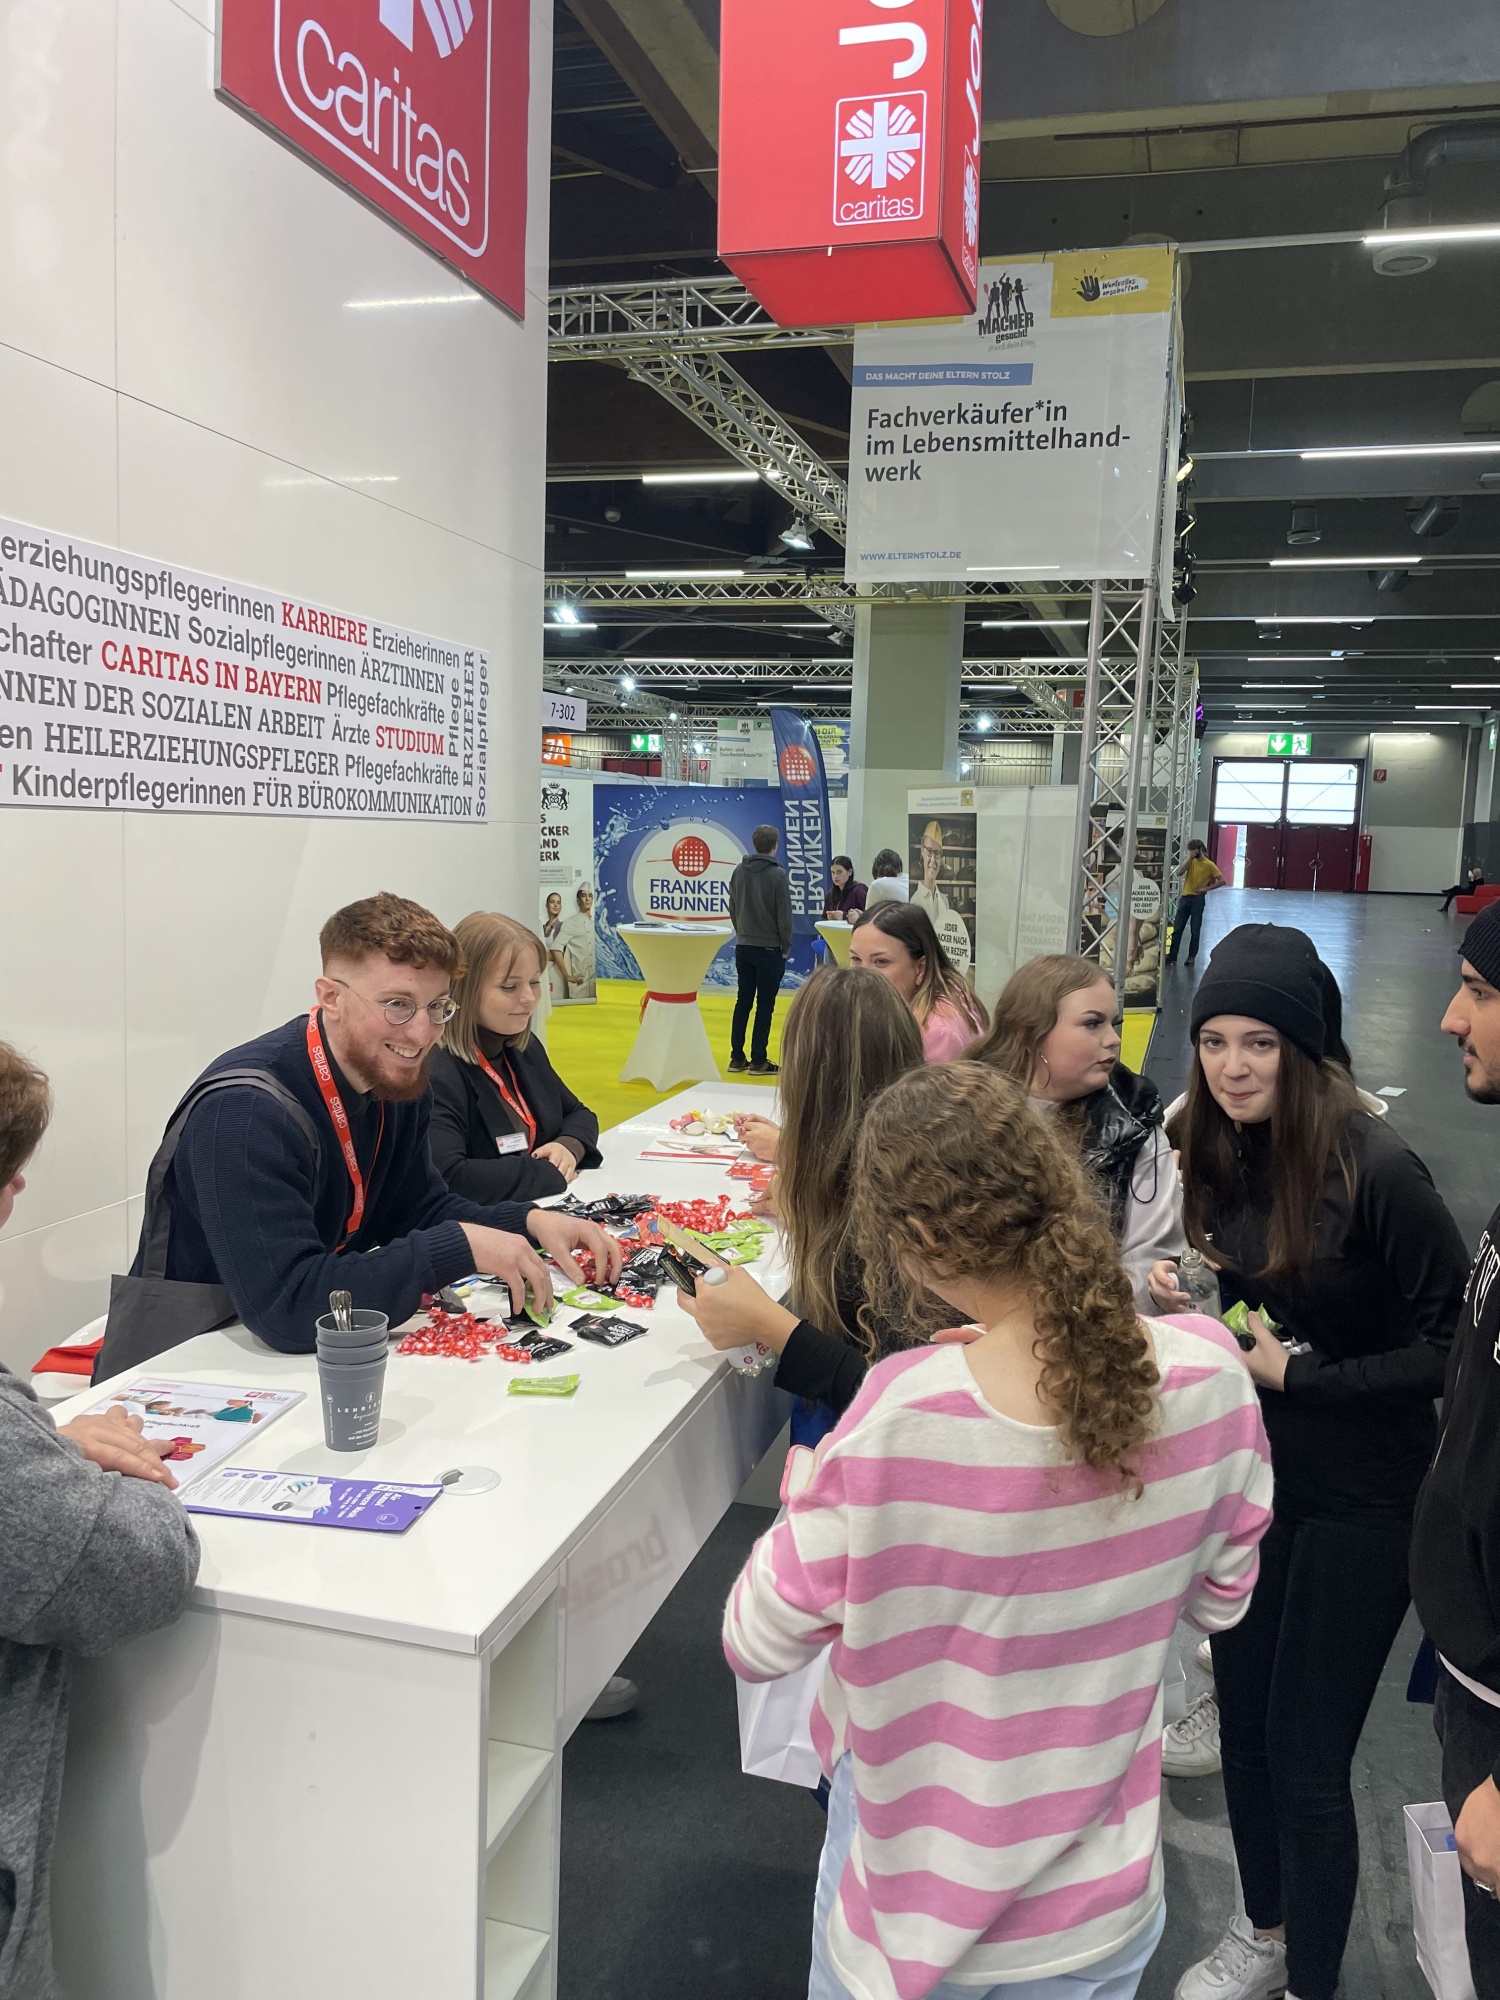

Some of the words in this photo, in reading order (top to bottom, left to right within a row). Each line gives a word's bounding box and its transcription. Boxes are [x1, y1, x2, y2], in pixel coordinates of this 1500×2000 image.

[297, 18, 471, 227] caritas
[840, 194, 914, 222] caritas
[978, 312, 1034, 336] MACHER
[865, 372, 884, 382] DAS
[885, 371, 917, 381] MACHT
[918, 371, 944, 381] DEINE
[945, 371, 979, 380] ELTERN
[981, 370, 1010, 380] STOLZ
[866, 434, 895, 456] im
[902, 425, 1131, 455] Lebensmittelhand-
[865, 459, 922, 482] werk
[860, 551, 962, 561] WWW.ELTERNSTOLZ.DE
[281, 601, 368, 646] KARRIERE
[373, 626, 460, 669] Erzieherinnen
[188, 616, 356, 676] Sozialpflegerinnen
[360, 651, 445, 695] ÄRZTINNEN
[101, 640, 209, 686] CARITAS
[215, 661, 239, 691] IN
[245, 667, 322, 705] BAYERN
[327, 682, 445, 725] Pflegefachkräfte
[84, 681, 135, 716] DER
[142, 690, 253, 731] SOZIALEN
[257, 708, 325, 740] ARBEIT
[332, 713, 370, 746] Ärzte
[375, 725, 445, 755] STUDIUM
[449, 677, 462, 758] Pflege
[463, 651, 474, 788] ERZIEHER
[551, 702, 575, 721] 7-302
[476, 653, 489, 818] Sozialpfleger
[44, 721, 340, 777] HEILERZIEHUNGSPFLEGER
[345, 753, 459, 787] Pflegefachkräfte
[12, 763, 246, 809] Kinderpflegerinnen
[253, 776, 293, 808] FÜR
[298, 780, 472, 816] BÜROKOMMUNIKATION
[649, 879, 729, 896] FRANKEN
[649, 895, 729, 912] BRUNNEN
[944, 922, 958, 932] JEDER
[953, 935, 967, 945] NACH
[313, 1045, 330, 1082] caritas
[330, 1096, 347, 1129] caritas
